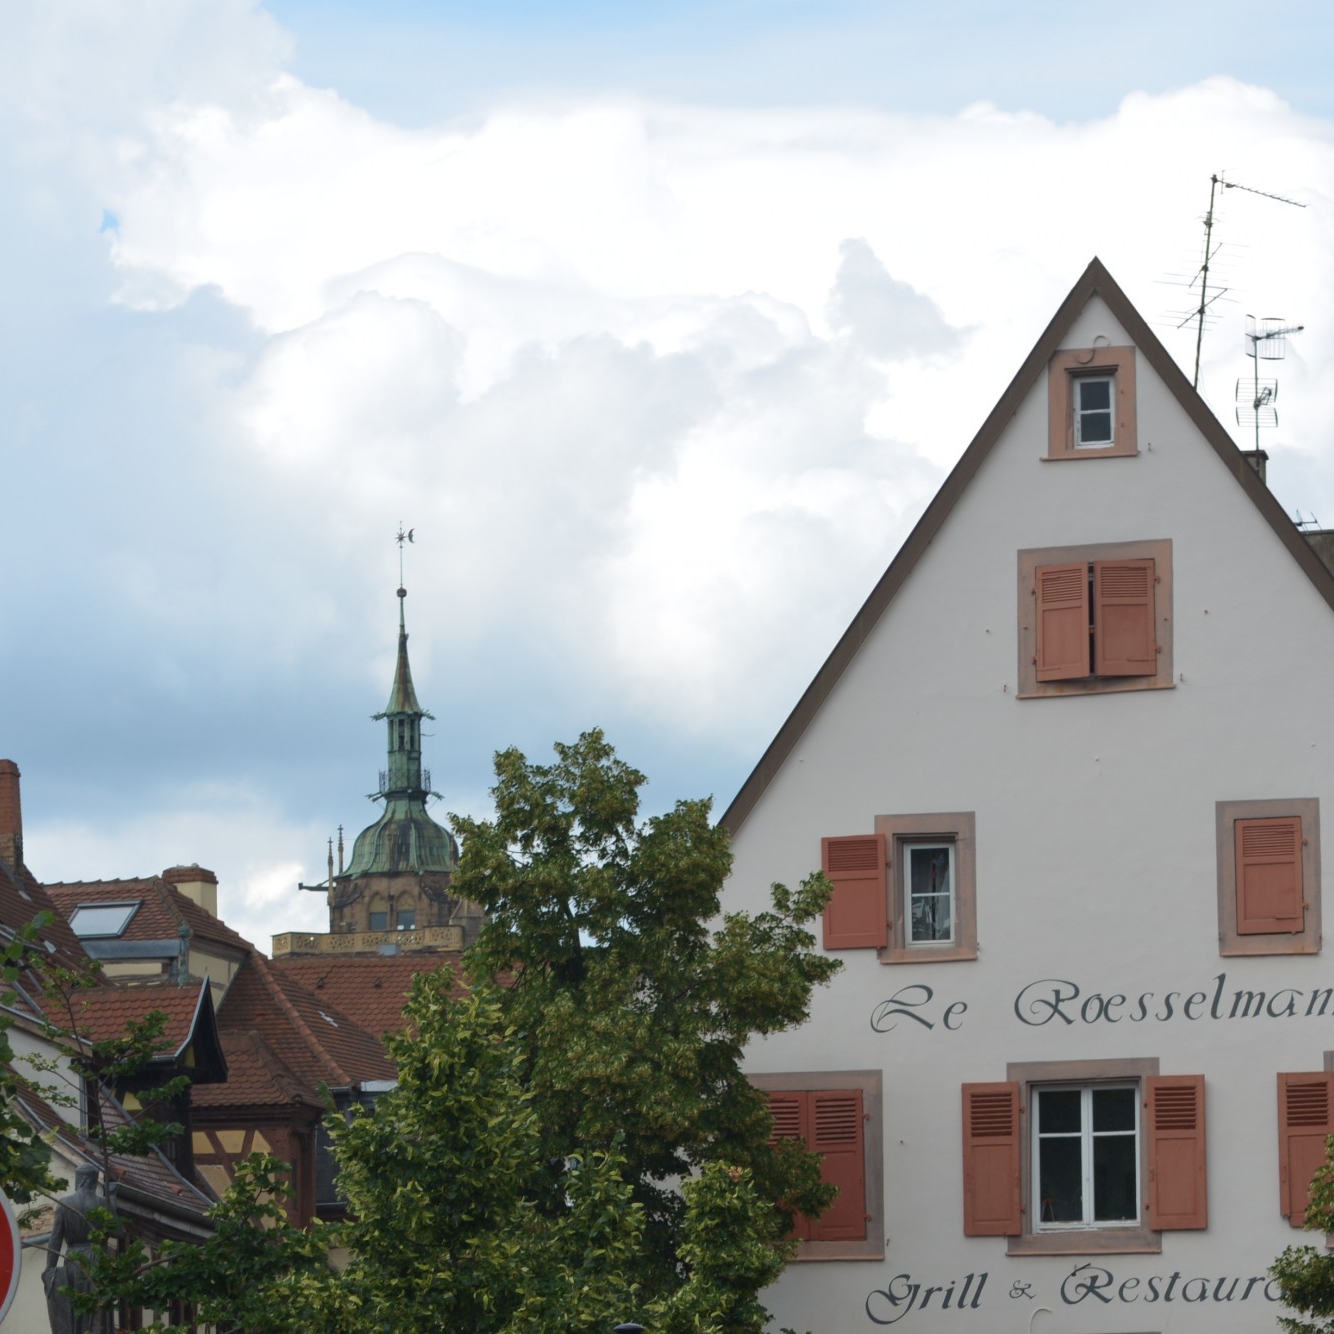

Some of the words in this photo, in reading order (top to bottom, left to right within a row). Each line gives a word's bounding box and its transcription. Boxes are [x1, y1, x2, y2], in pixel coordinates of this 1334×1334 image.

[870, 984, 968, 1033] Le
[866, 1272, 989, 1324] Grill
[1008, 1279, 1036, 1299] &
[1060, 1264, 1286, 1305] Restaura
